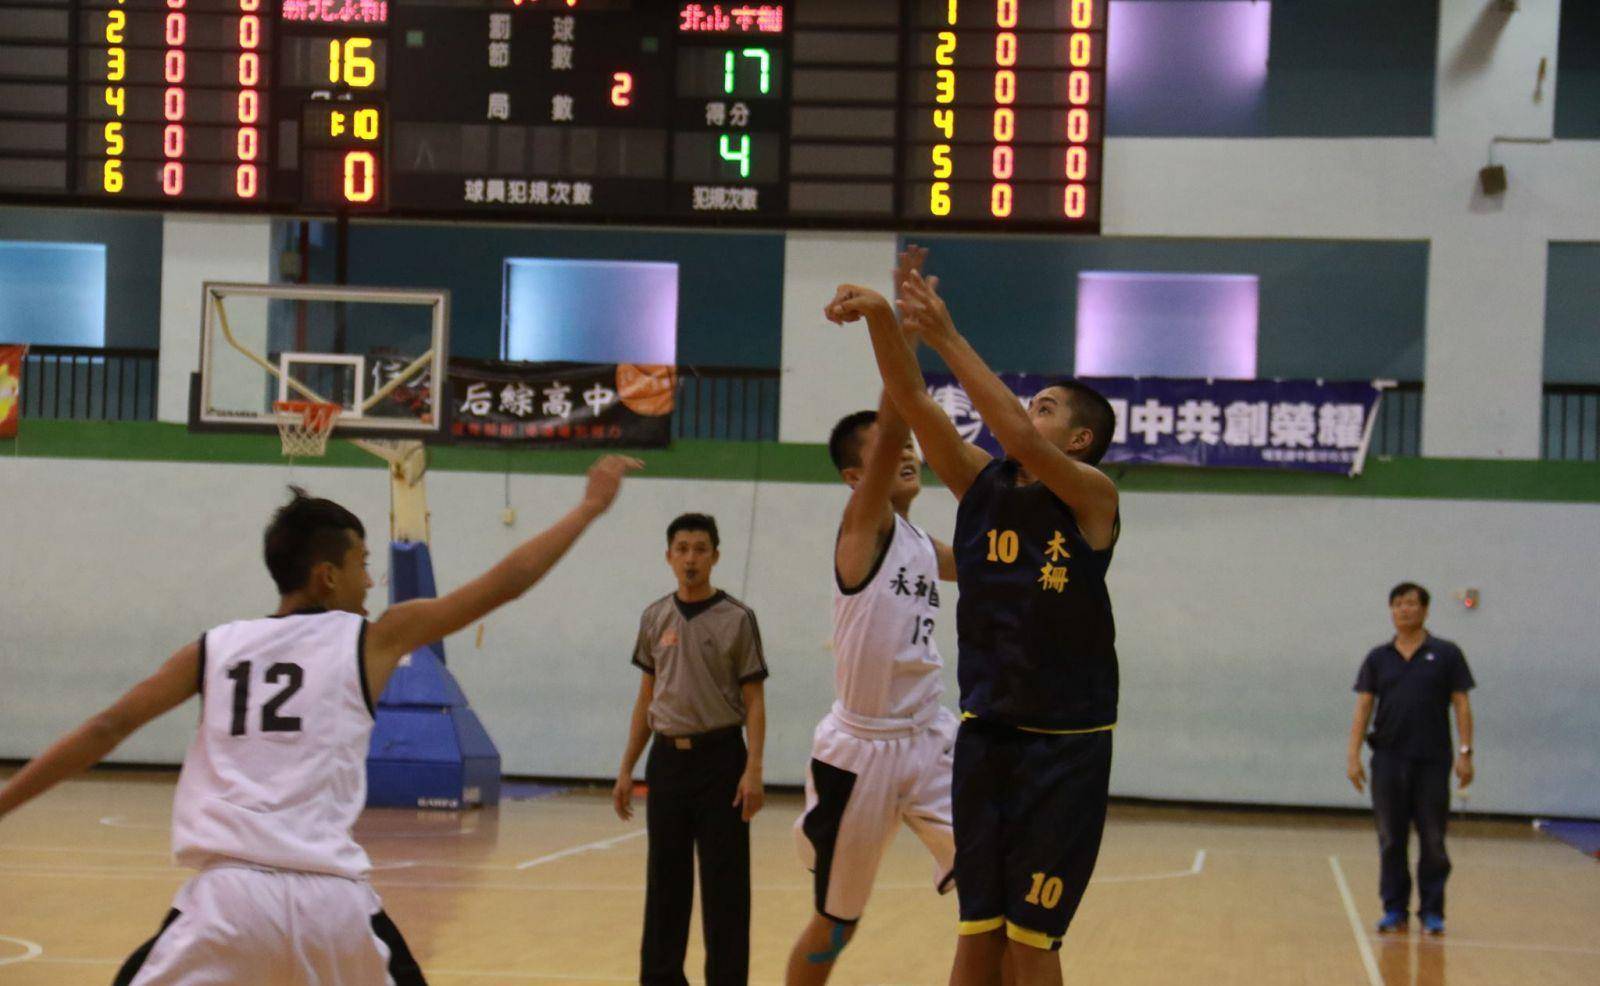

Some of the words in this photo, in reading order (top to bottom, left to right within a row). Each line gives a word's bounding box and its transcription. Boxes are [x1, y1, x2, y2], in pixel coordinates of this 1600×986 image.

[106, 10, 125, 43] 2
[166, 12, 186, 46] 0
[239, 15, 260, 48] 0
[107, 48, 125, 80] 3
[165, 49, 185, 83] 0
[239, 52, 259, 86] 0
[329, 38, 375, 87] 16
[936, 32, 956, 66] 2
[996, 32, 1017, 67] 0
[1069, 32, 1091, 68] 0
[611, 72, 633, 107] 2
[724, 48, 770, 94] 17
[936, 69, 955, 103] 3
[995, 70, 1016, 104] 0
[1068, 70, 1090, 105] 0
[105, 87, 125, 116] 4
[164, 87, 185, 121] 0
[238, 89, 258, 123] 0
[705, 102, 750, 126] 得分
[105, 122, 124, 156] 5
[164, 124, 184, 157] 0
[237, 127, 258, 161] 0
[933, 109, 953, 139] 4
[994, 108, 1014, 142] 0
[1067, 108, 1089, 143] 0
[720, 134, 750, 178] 4
[932, 145, 952, 178] 5
[993, 145, 1013, 180] 0
[1065, 146, 1087, 181] 0
[104, 159, 123, 192] 6
[163, 161, 183, 195] 0
[236, 164, 257, 198] 0
[344, 151, 375, 202] 0
[931, 182, 950, 216] 6
[991, 182, 1012, 217] 0
[1064, 183, 1086, 218] 0
[986, 529, 1019, 564] 10
[1037, 530, 1070, 593] 木柵
[227, 660, 304, 736] 12
[1025, 872, 1064, 909] 10
